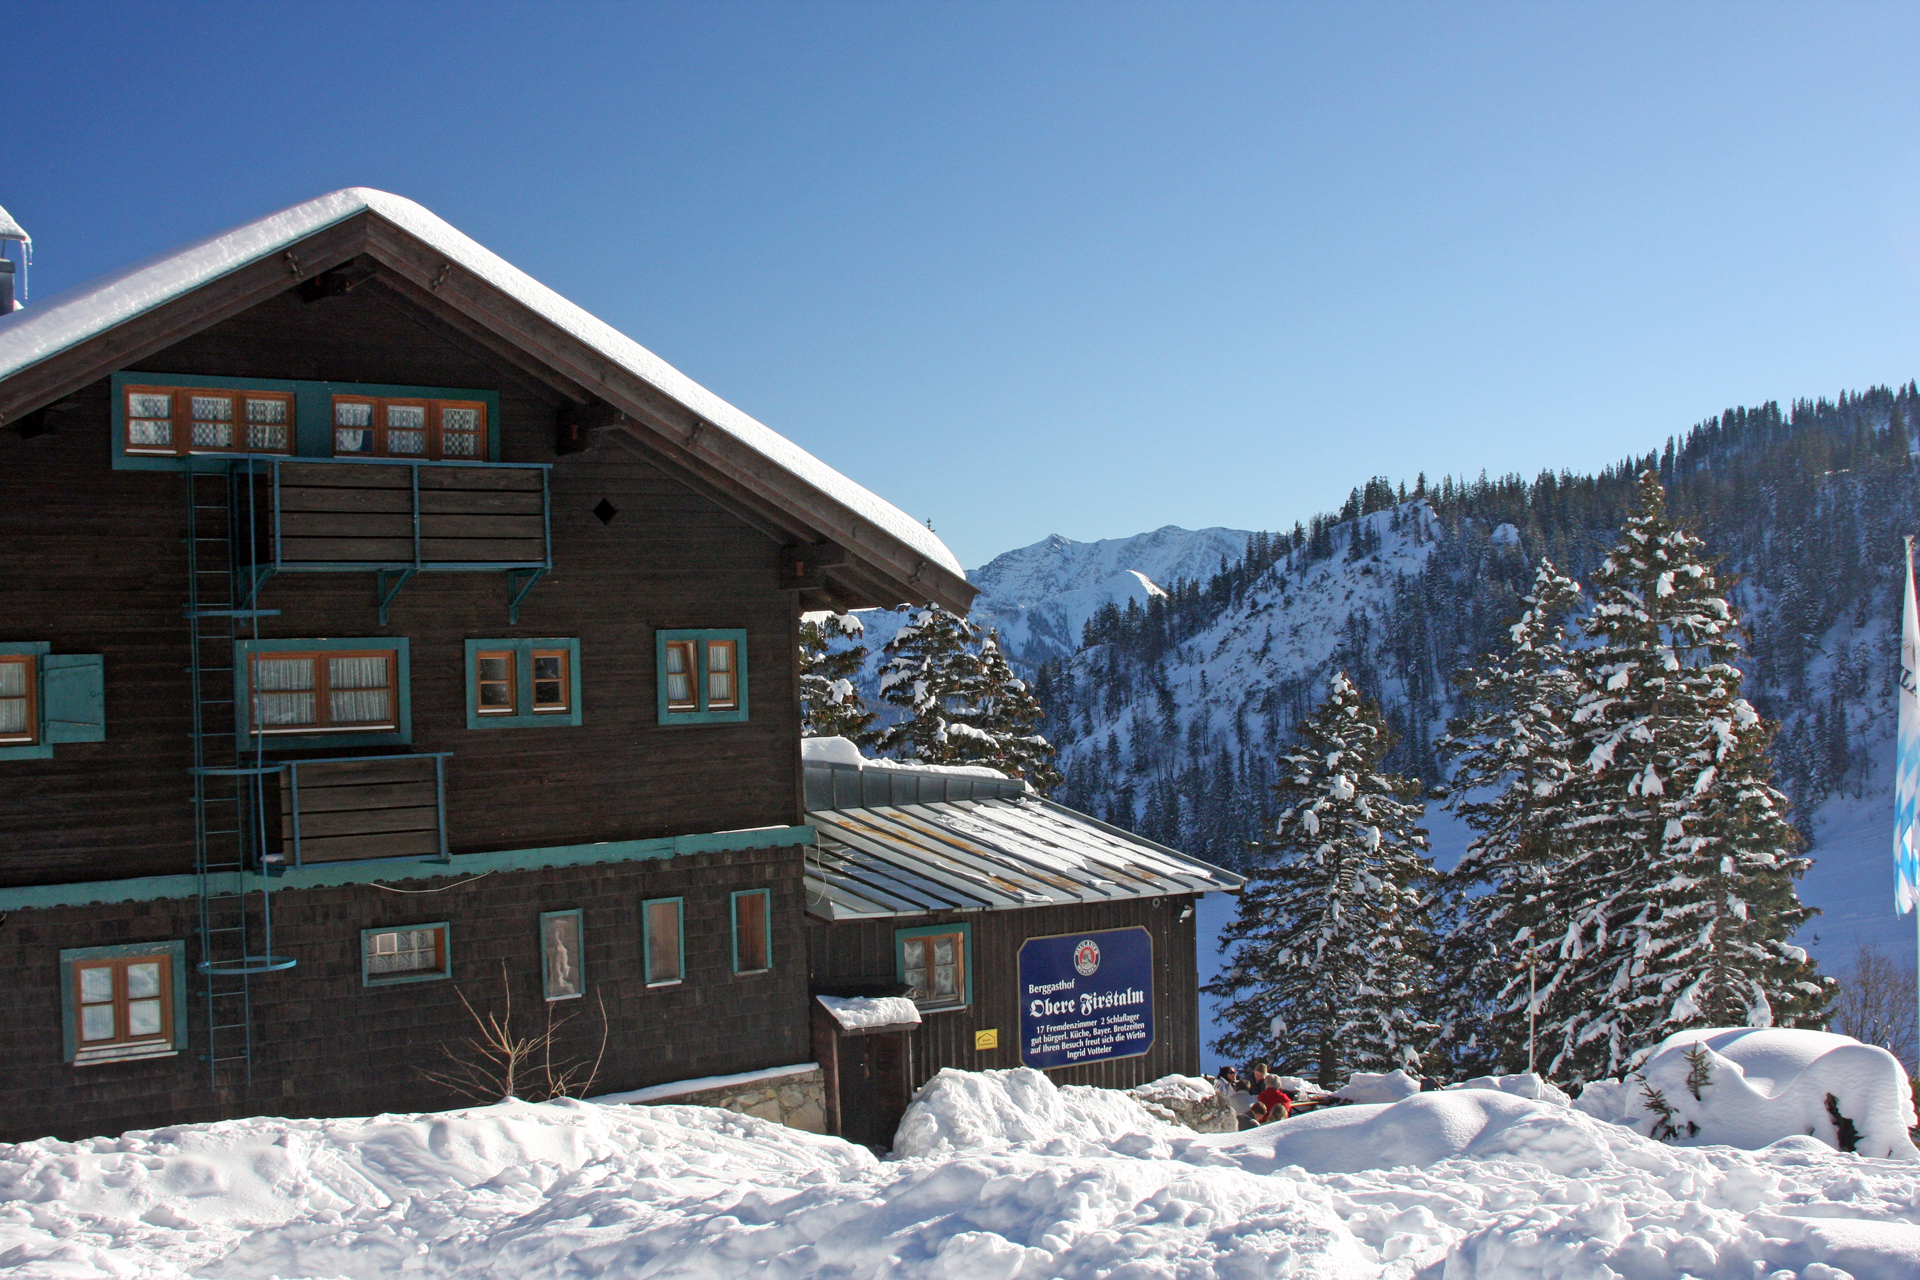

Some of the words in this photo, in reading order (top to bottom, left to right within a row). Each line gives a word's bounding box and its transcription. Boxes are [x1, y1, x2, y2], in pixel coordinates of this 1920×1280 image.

[1028, 978, 1075, 994] Berggasthof
[1030, 998, 1075, 1017] Obere
[1080, 987, 1144, 1016] Firstalm
[1030, 1036, 1042, 1047] gut
[1043, 1031, 1069, 1043] bürgerl.
[1070, 1029, 1091, 1038] Küche,
[1092, 1027, 1112, 1036] Bayer.
[1113, 1022, 1145, 1033] Brotzeiten
[1036, 1025, 1045, 1034] 17
[1046, 1020, 1097, 1032] Fremdenzimmer
[1100, 1016, 1105, 1025] 2
[1106, 1013, 1140, 1024] Schlaflager
[1030, 1044, 1041, 1055] auf
[1042, 1043, 1060, 1053] Ihren
[1061, 1039, 1083, 1050] Besuch
[1085, 1037, 1101, 1047] freut
[1101, 1034, 1114, 1045] sich
[1115, 1032, 1125, 1042] die
[1126, 1030, 1146, 1039] Wirtin
[1066, 1048, 1086, 1060] Ingrid
[1087, 1044, 1112, 1056] Votteler
